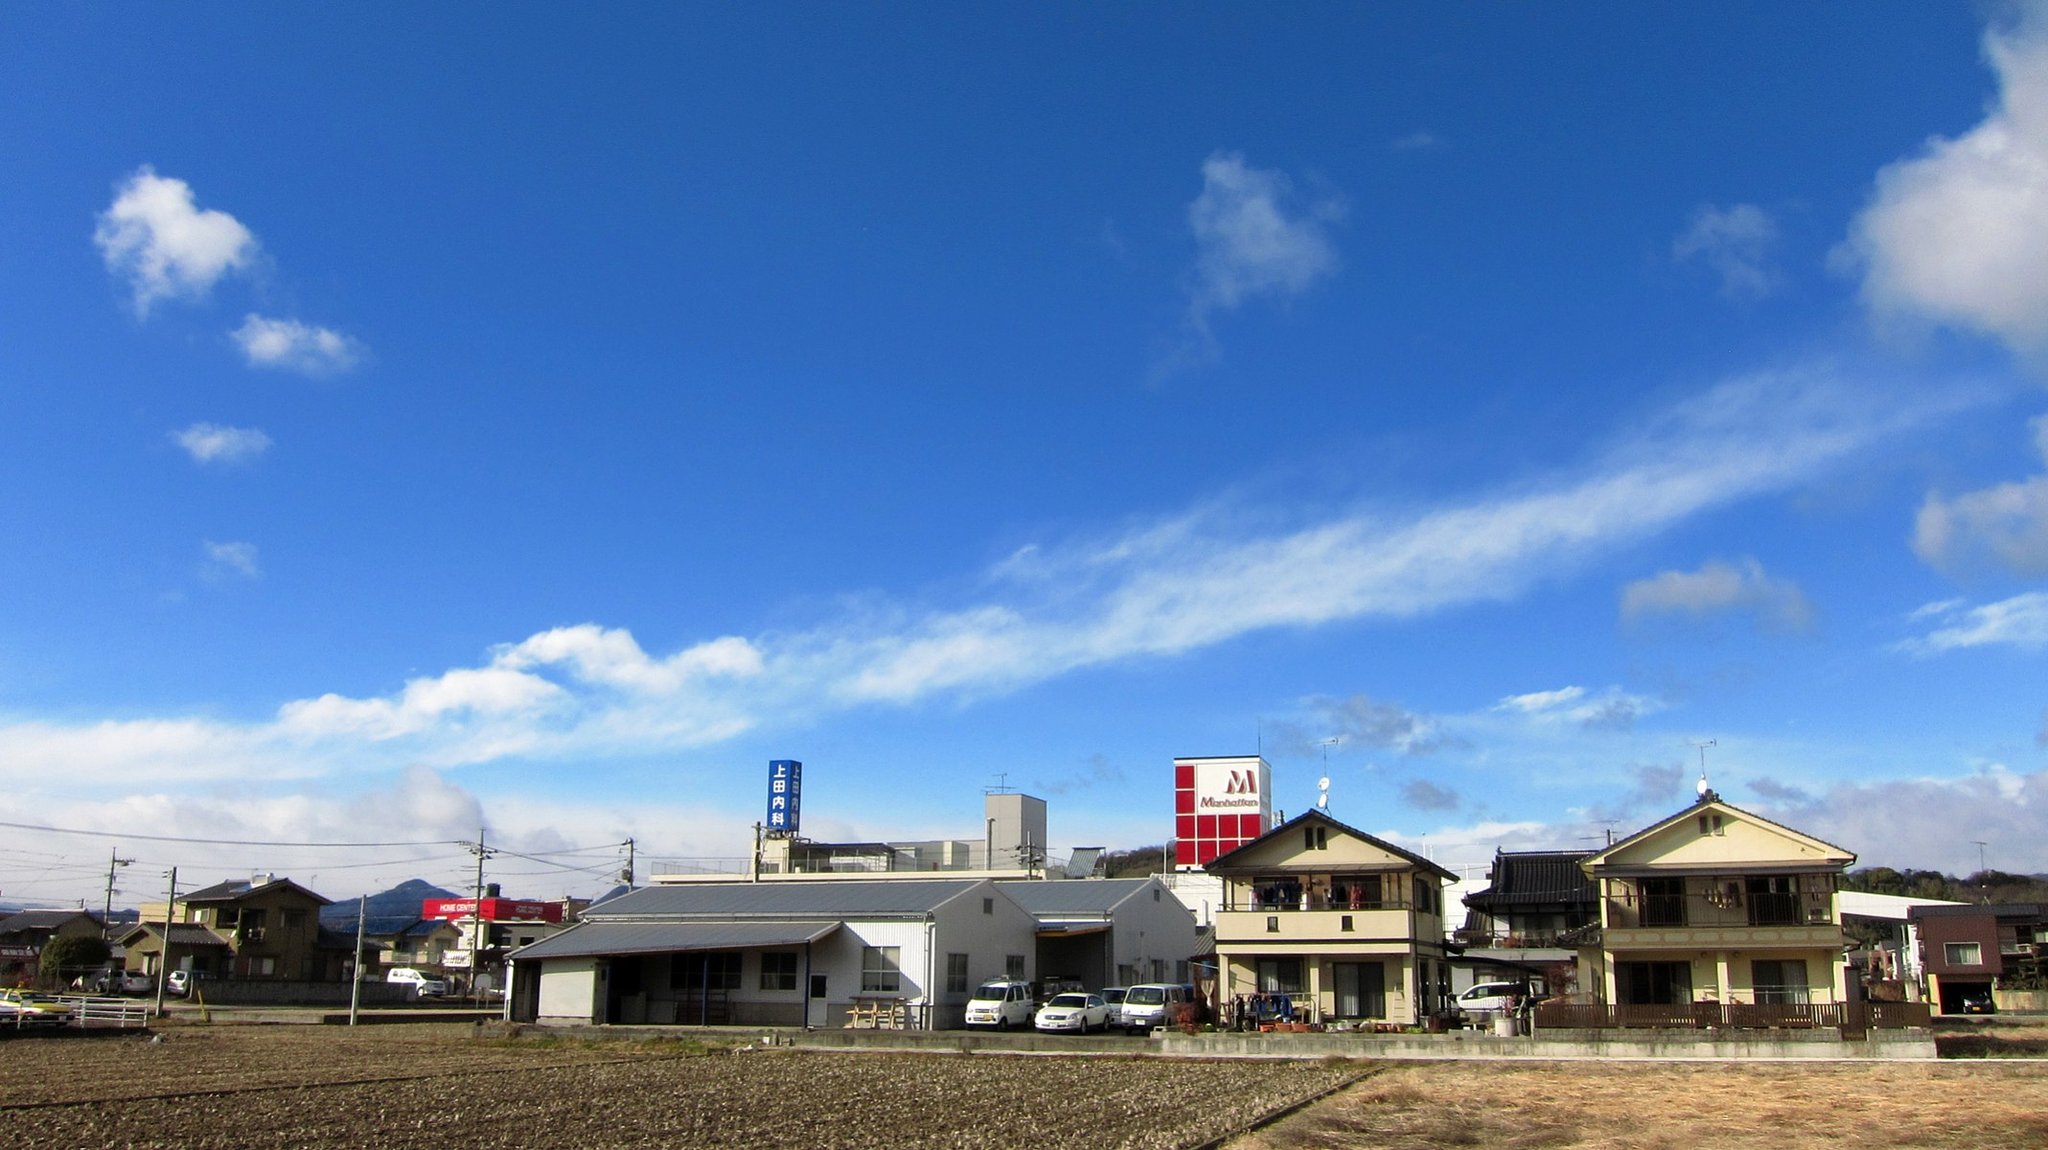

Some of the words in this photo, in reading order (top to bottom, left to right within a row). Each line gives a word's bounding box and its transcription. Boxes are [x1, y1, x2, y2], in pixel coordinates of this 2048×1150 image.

[771, 764, 786, 826] 上田内科
[1200, 796, 1259, 808] Manhattan
[439, 903, 456, 912] HOME
